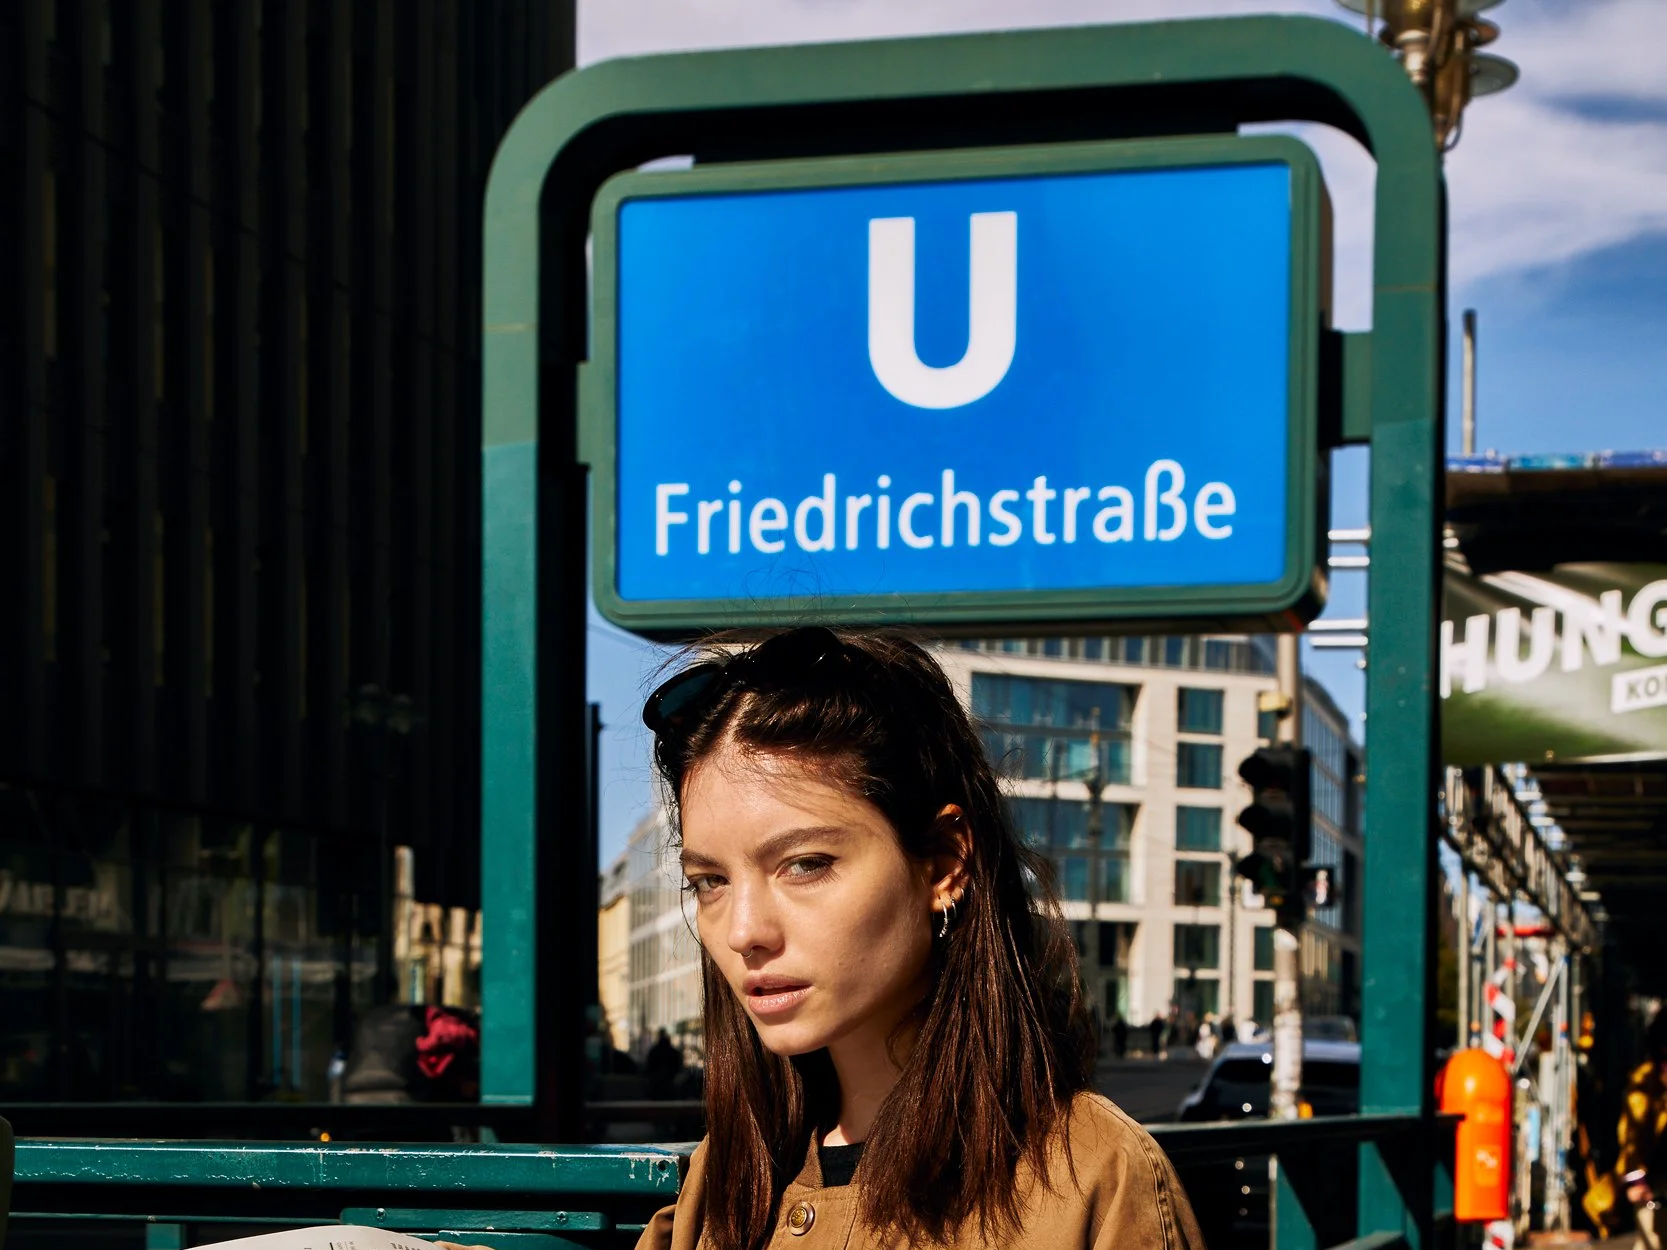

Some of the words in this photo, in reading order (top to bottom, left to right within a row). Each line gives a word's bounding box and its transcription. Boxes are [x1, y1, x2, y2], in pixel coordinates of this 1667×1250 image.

[868, 211, 1017, 409] U
[655, 459, 1236, 556] Friedrichstraße
[1626, 676, 1667, 700] KO
